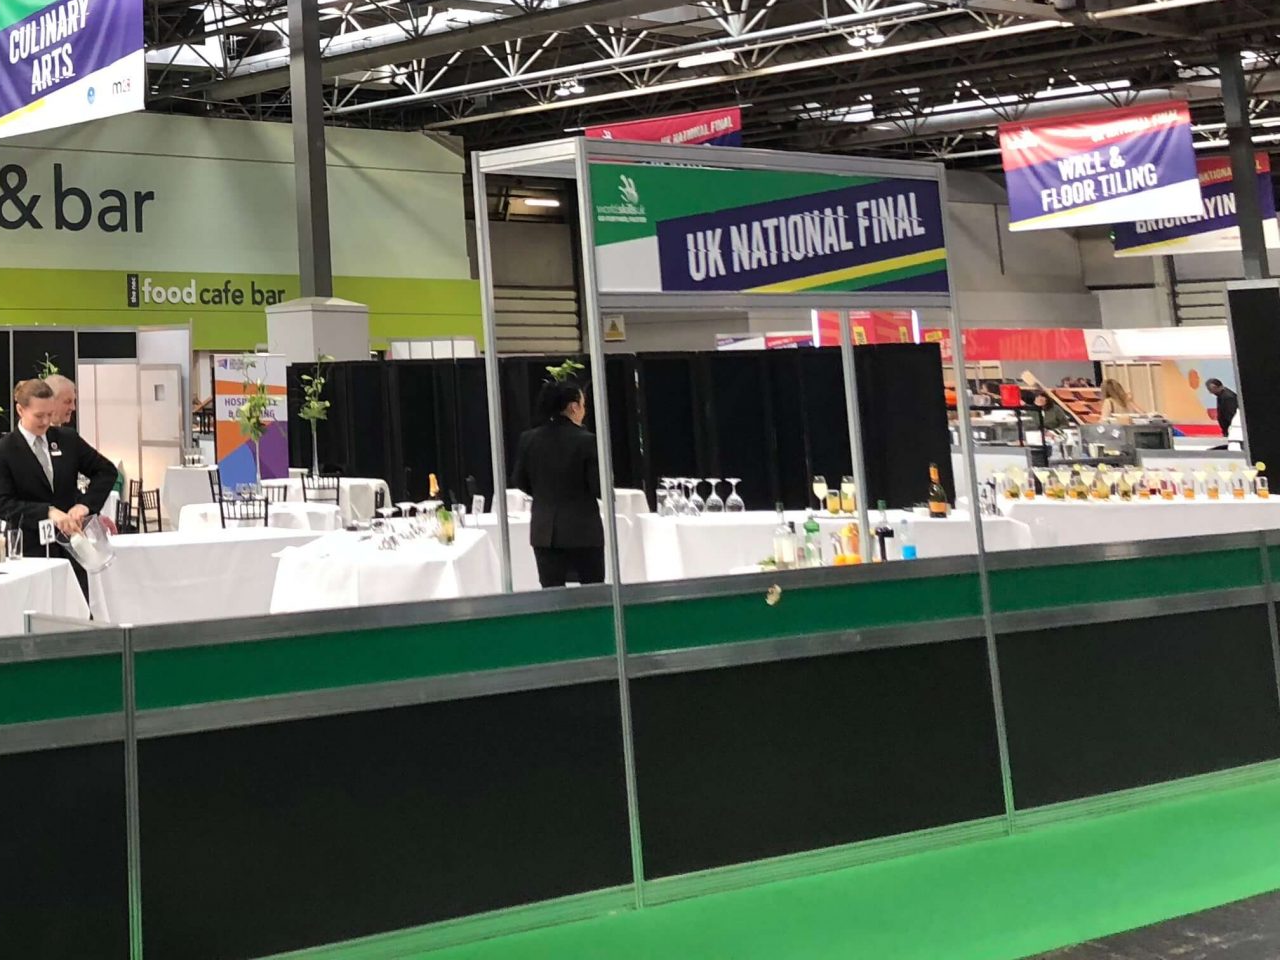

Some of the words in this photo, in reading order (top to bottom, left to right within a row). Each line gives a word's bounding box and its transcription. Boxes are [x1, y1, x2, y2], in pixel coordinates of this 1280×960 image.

[31, 43, 76, 95] ARTS
[1041, 179, 1097, 212] FLOOR
[1100, 162, 1159, 199] TILING
[1057, 152, 1106, 182] WALL
[1108, 145, 1126, 170] &
[53, 162, 155, 233] bar
[686, 228, 726, 282] UK
[729, 205, 854, 274] NATIONAL
[855, 191, 926, 248] FINAL
[141, 278, 196, 305] food
[199, 280, 245, 306] cafe
[251, 280, 286, 306] bar
[41, 522, 52, 540] 12
